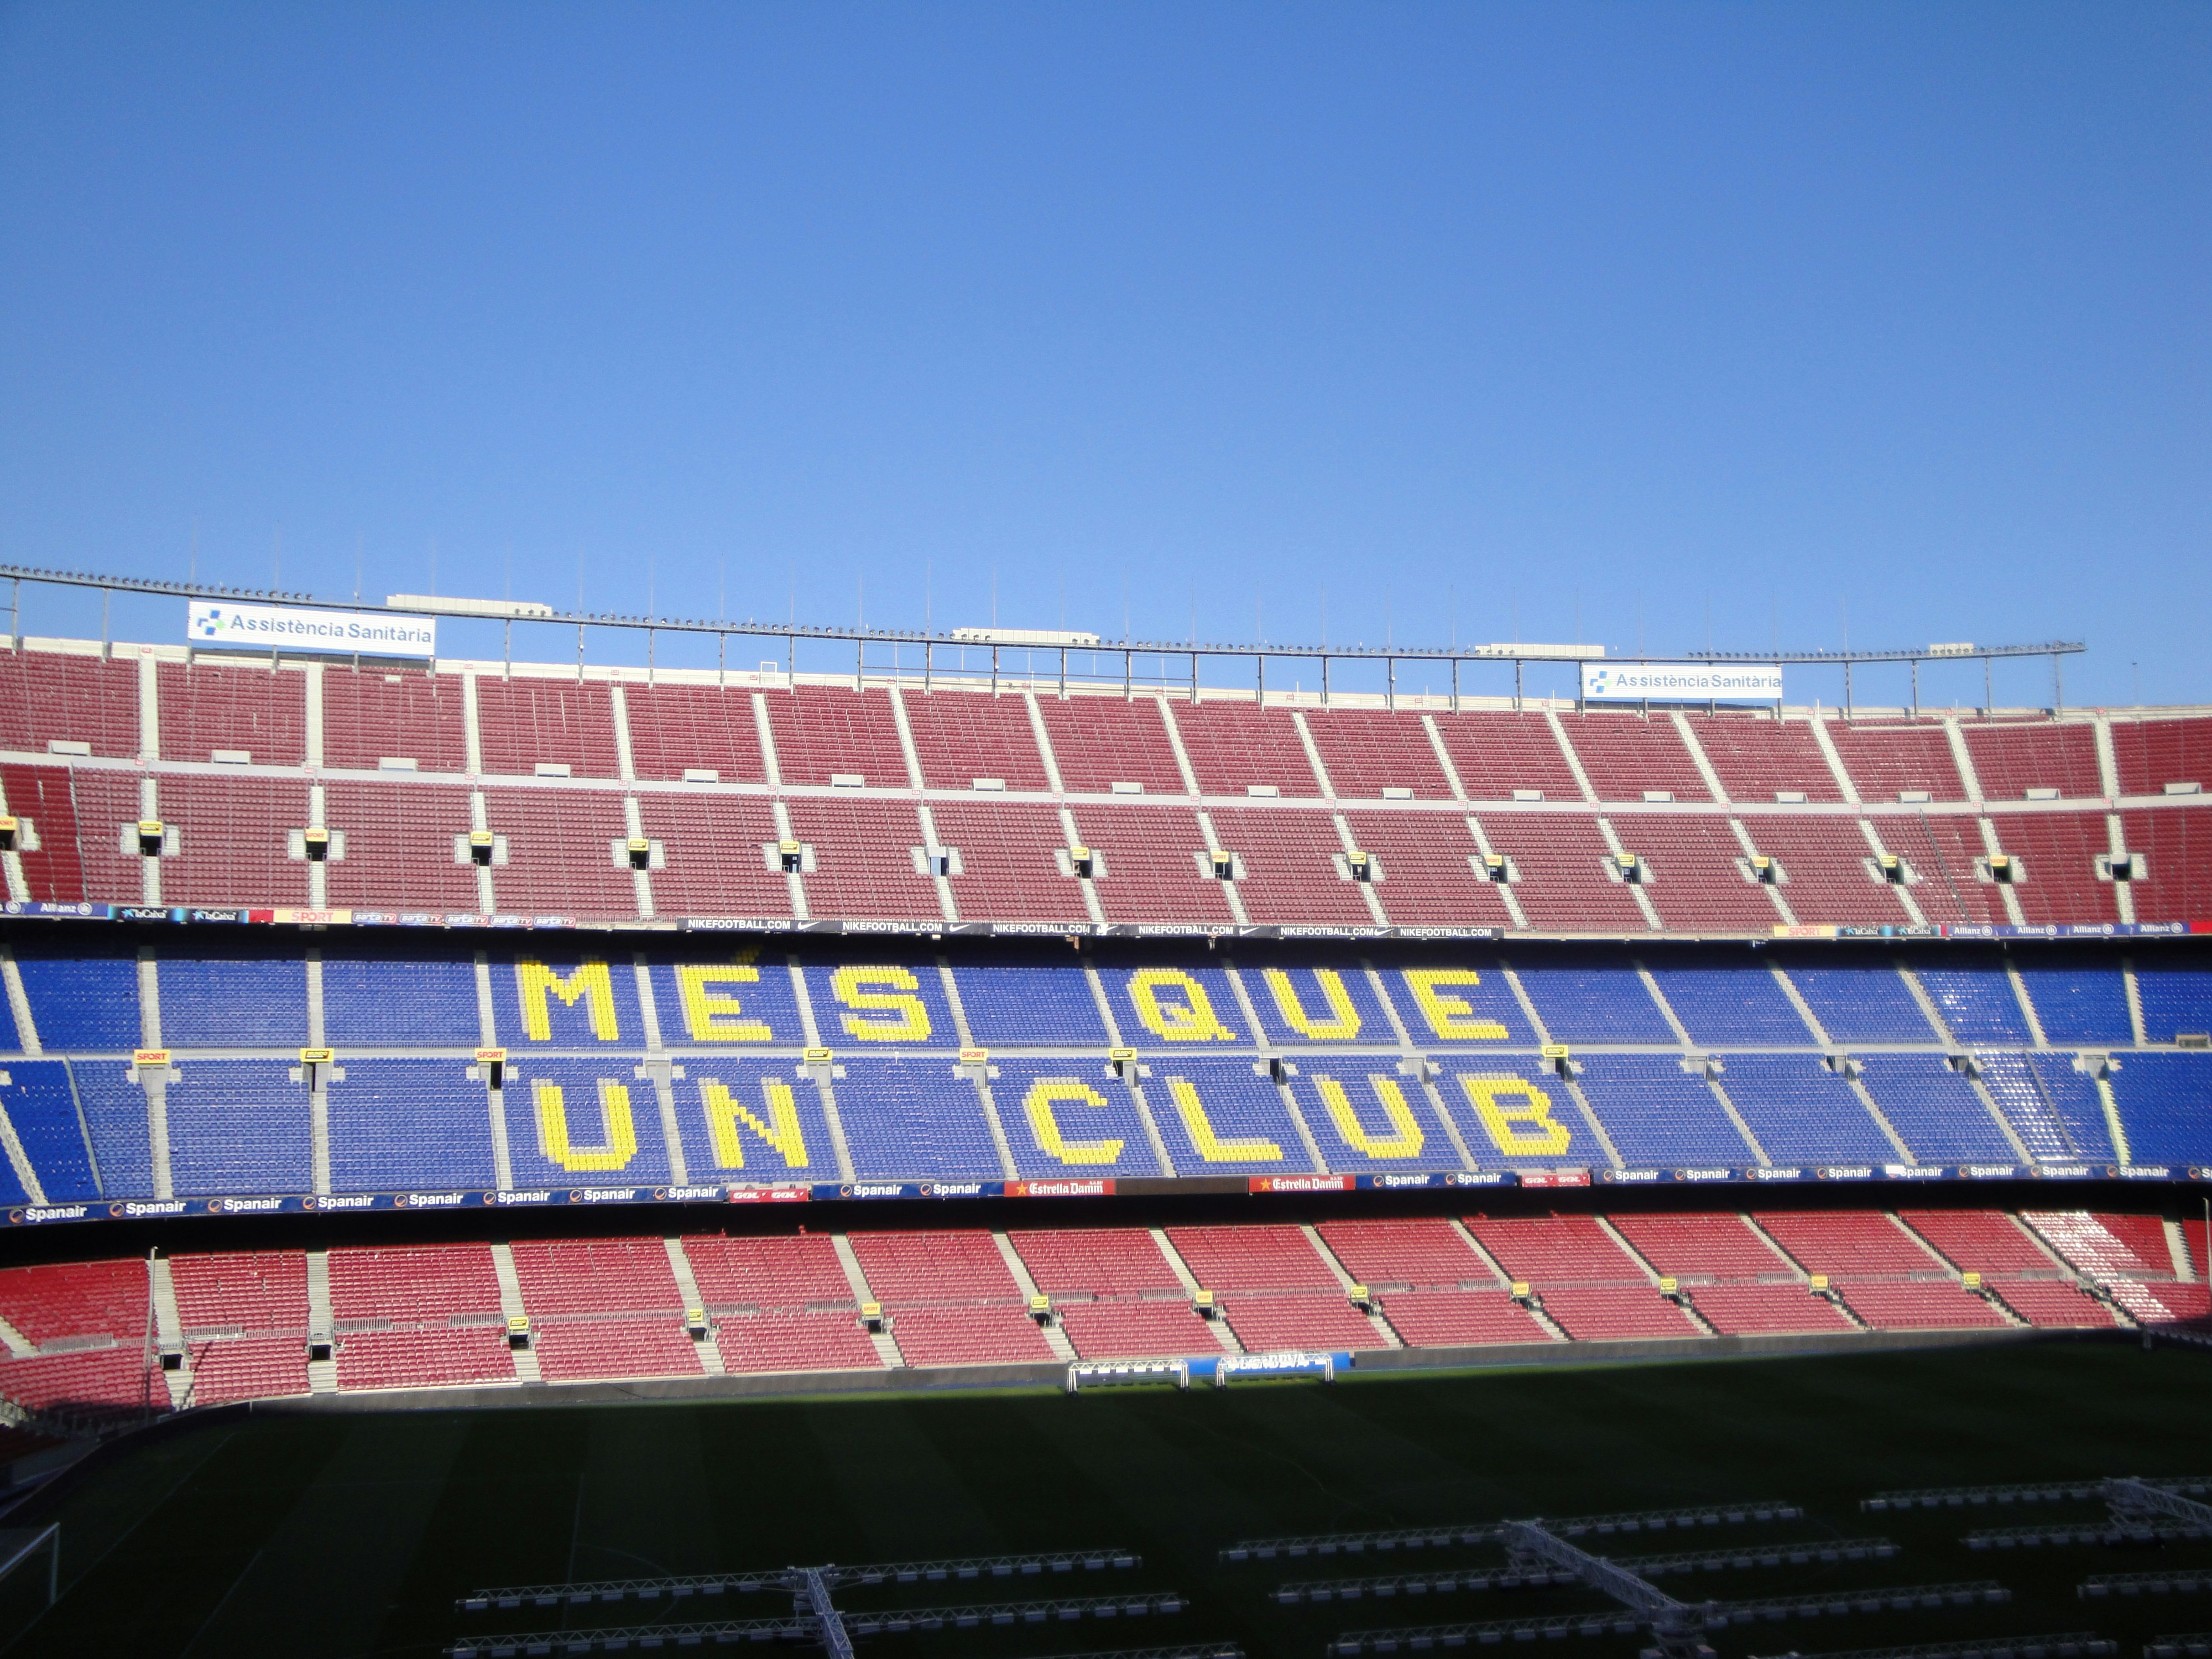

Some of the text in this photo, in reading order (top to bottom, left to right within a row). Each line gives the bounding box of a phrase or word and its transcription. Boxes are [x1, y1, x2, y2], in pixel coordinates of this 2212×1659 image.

[231, 614, 432, 643] Assistència Sanitària
[1616, 674, 1781, 688] Assistència Sanitària
[40, 903, 76, 913] Allianz
[292, 912, 333, 921] SPORT
[688, 920, 790, 930] NIKEFOOTBALL.COM
[843, 922, 942, 932] NIKEFOOTBALL.COM
[2017, 926, 2044, 935] Allianz
[2073, 925, 2101, 933] Allianz
[2141, 924, 2170, 932] Allianz
[1139, 927, 1233, 936] NIKEFOOTBALL.COM
[1281, 928, 1374, 937] NIKEFOOTBALL.COM
[1400, 929, 1491, 937] NIKEFOOTBALL.COM
[1788, 927, 1820, 936] SPORT
[1128, 968, 1509, 1040] QUE
[531, 1074, 1571, 1171] UN CLUB
[1615, 1170, 1658, 1182] Spanair
[1687, 1170, 1730, 1181] Spanair
[1758, 1168, 1801, 1180] Spanair
[1829, 1167, 1871, 1180] Spanair
[1901, 1167, 1942, 1178] Spanair
[1972, 1166, 2014, 1178] Spanair
[2043, 1165, 2089, 1177] Spanair
[2120, 1165, 2170, 1177] Spanair
[1273, 1178, 1344, 1190] Estrella Damm
[1385, 1175, 1430, 1187] Spanair
[1458, 1173, 1502, 1185] Spanair
[669, 1188, 718, 1200] Spanair
[853, 1185, 902, 1197] Spanair
[933, 1183, 981, 1196] Spanair
[1029, 1183, 1103, 1194] Estrella Damm
[409, 1194, 463, 1207] Spanair
[497, 1191, 550, 1204] Spanair
[583, 1190, 635, 1202] Spanair
[126, 1201, 186, 1216] Spanair
[224, 1198, 281, 1212] Spanair
[318, 1196, 374, 1210] Spanair
[25, 1206, 87, 1222] Spanair
